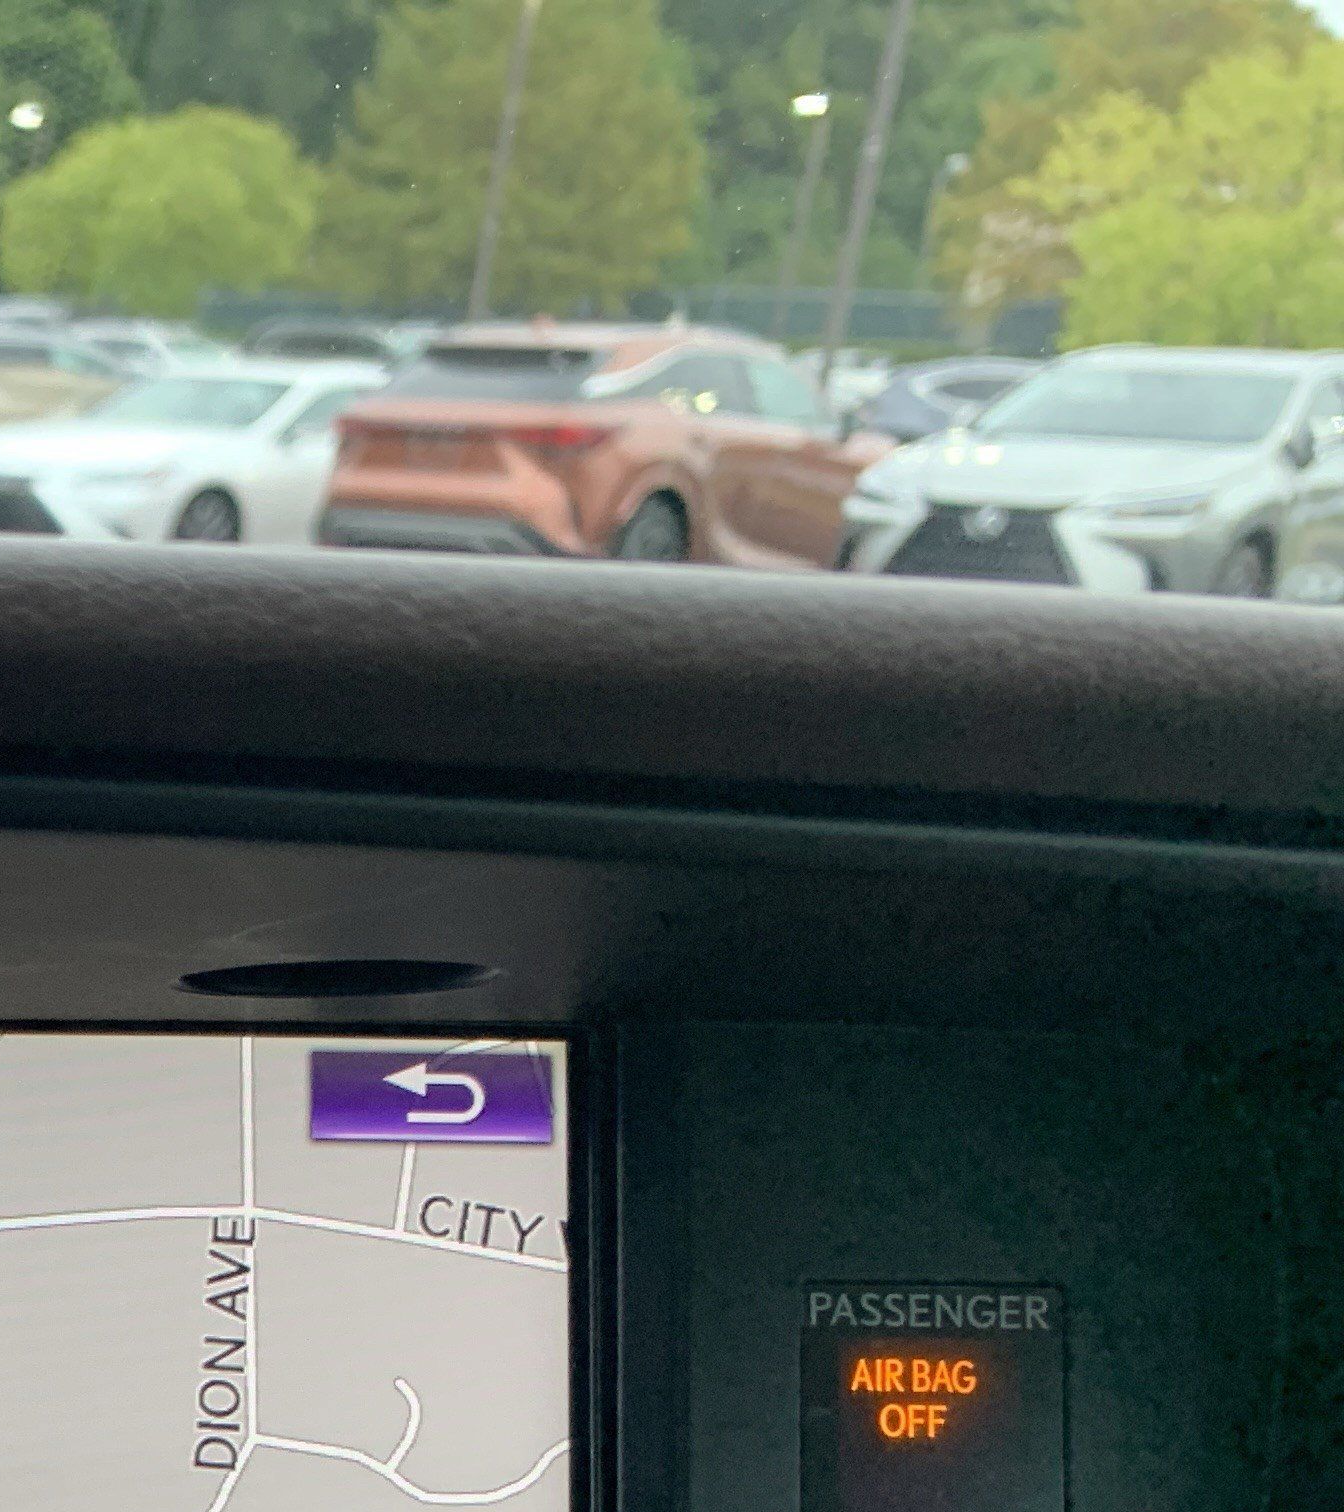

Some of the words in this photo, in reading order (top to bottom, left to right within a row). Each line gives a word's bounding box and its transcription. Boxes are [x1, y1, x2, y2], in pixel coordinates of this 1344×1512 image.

[420, 1195, 544, 1253] CITY
[206, 1216, 256, 1320] AVE
[809, 1292, 1050, 1330] PASSENGER
[850, 1358, 906, 1392] AIR
[911, 1360, 977, 1394] BAG
[193, 1336, 246, 1470] DION
[878, 1404, 948, 1438] OFF
